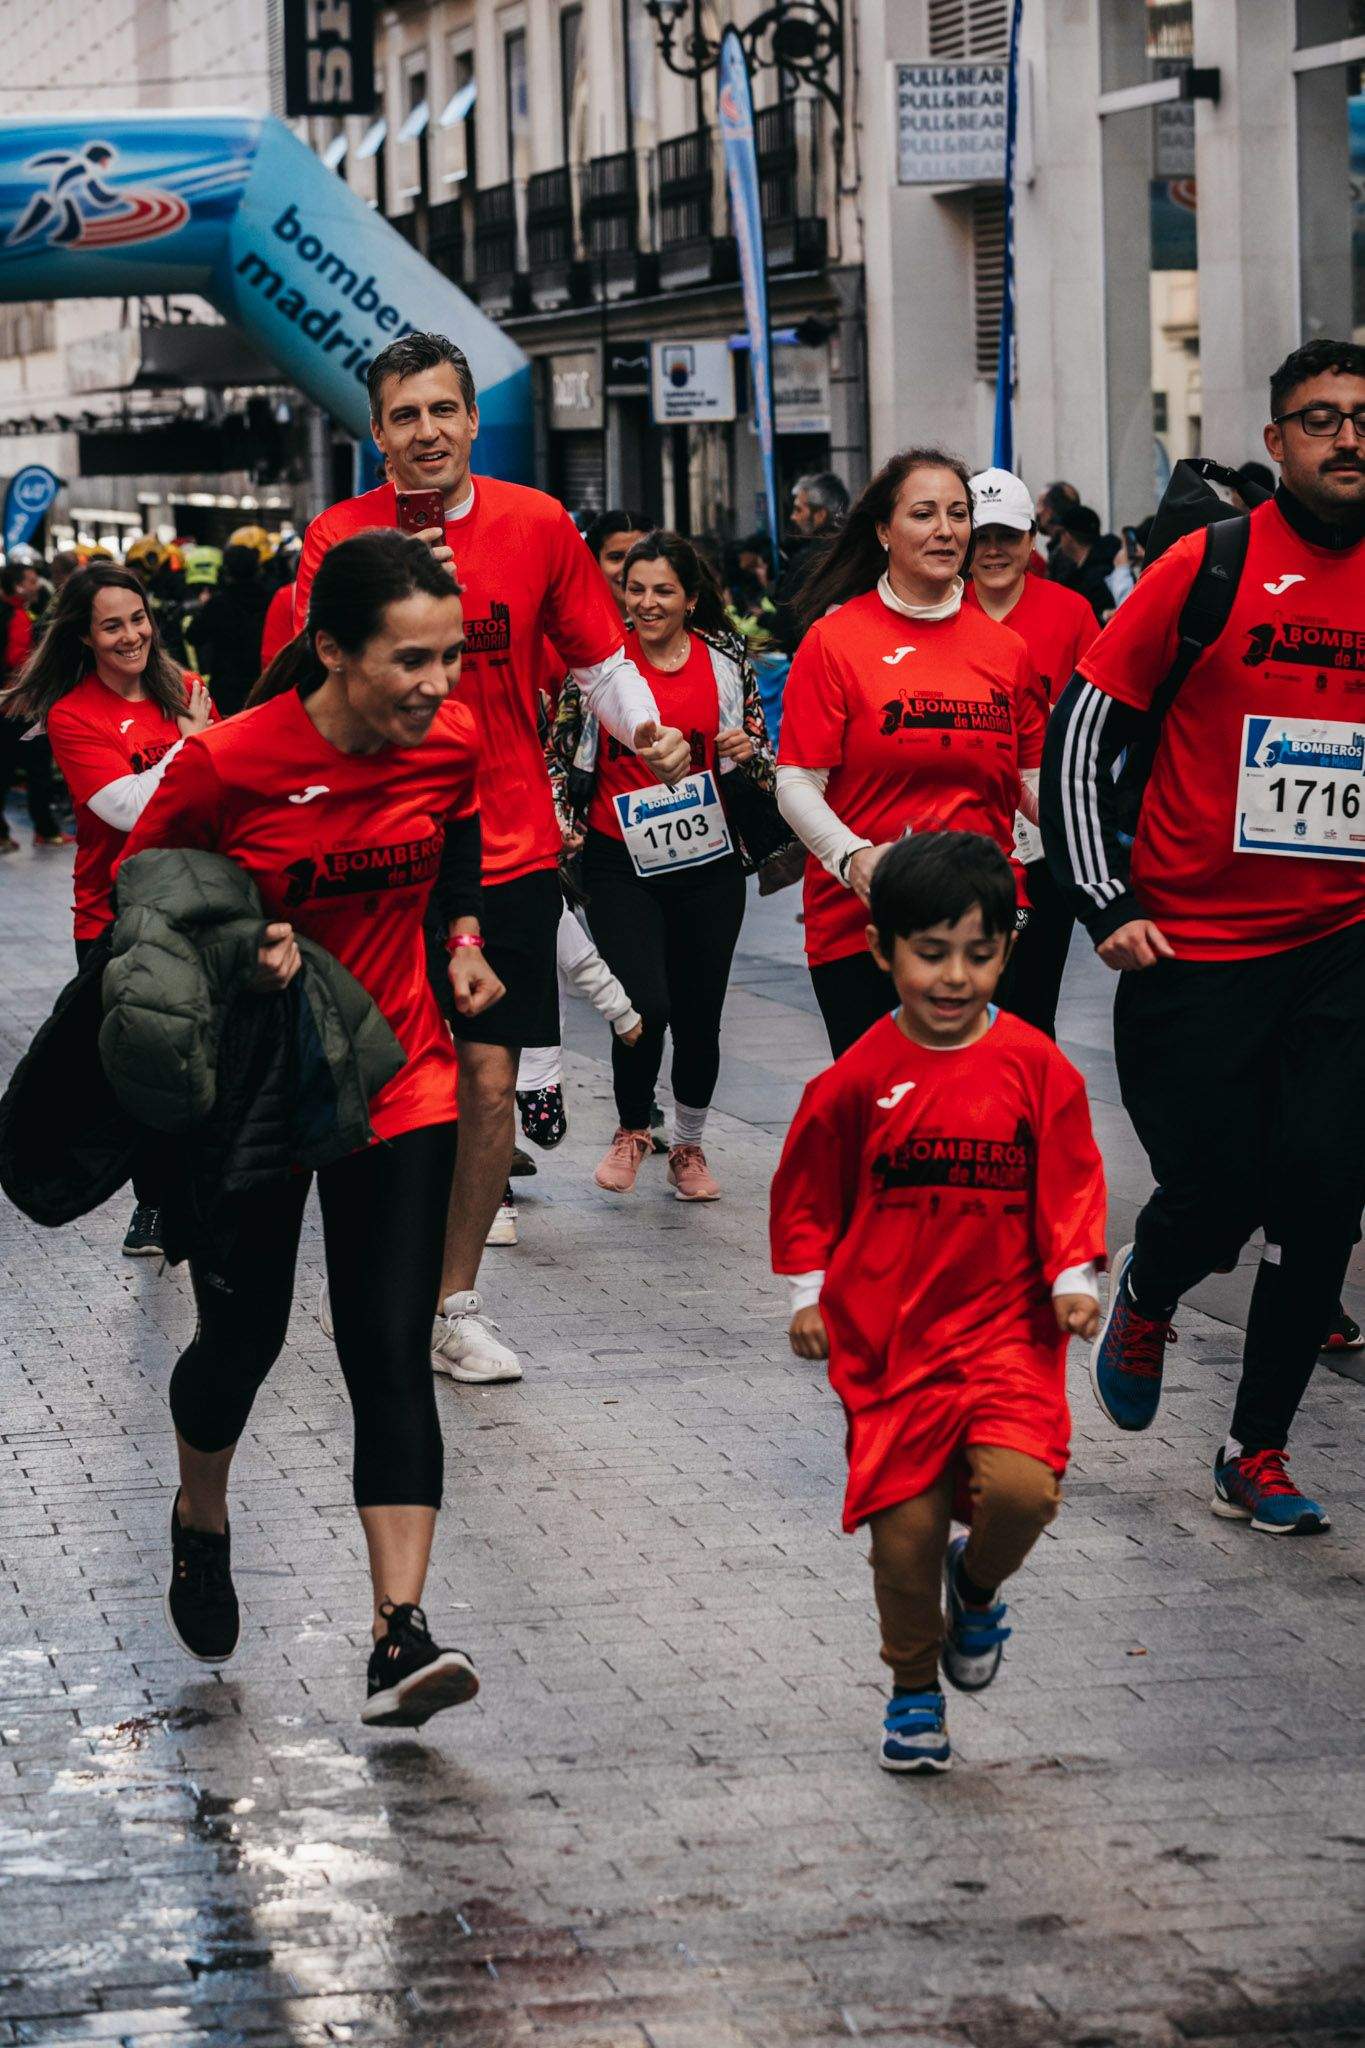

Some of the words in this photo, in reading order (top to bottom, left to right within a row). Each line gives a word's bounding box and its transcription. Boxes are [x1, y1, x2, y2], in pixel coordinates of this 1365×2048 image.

[899, 68, 1004, 86] PULL&BEAR
[899, 91, 1004, 108] PULL&BEAR
[899, 113, 1004, 131] PULL&BEAR
[915, 700, 1008, 718] BOMBEROS
[954, 715, 968, 729] de
[1291, 741, 1362, 757] BOMBEROS
[647, 790, 698, 811] BOMBEROS
[1269, 777, 1361, 819] 1716
[644, 813, 709, 849] 1703
